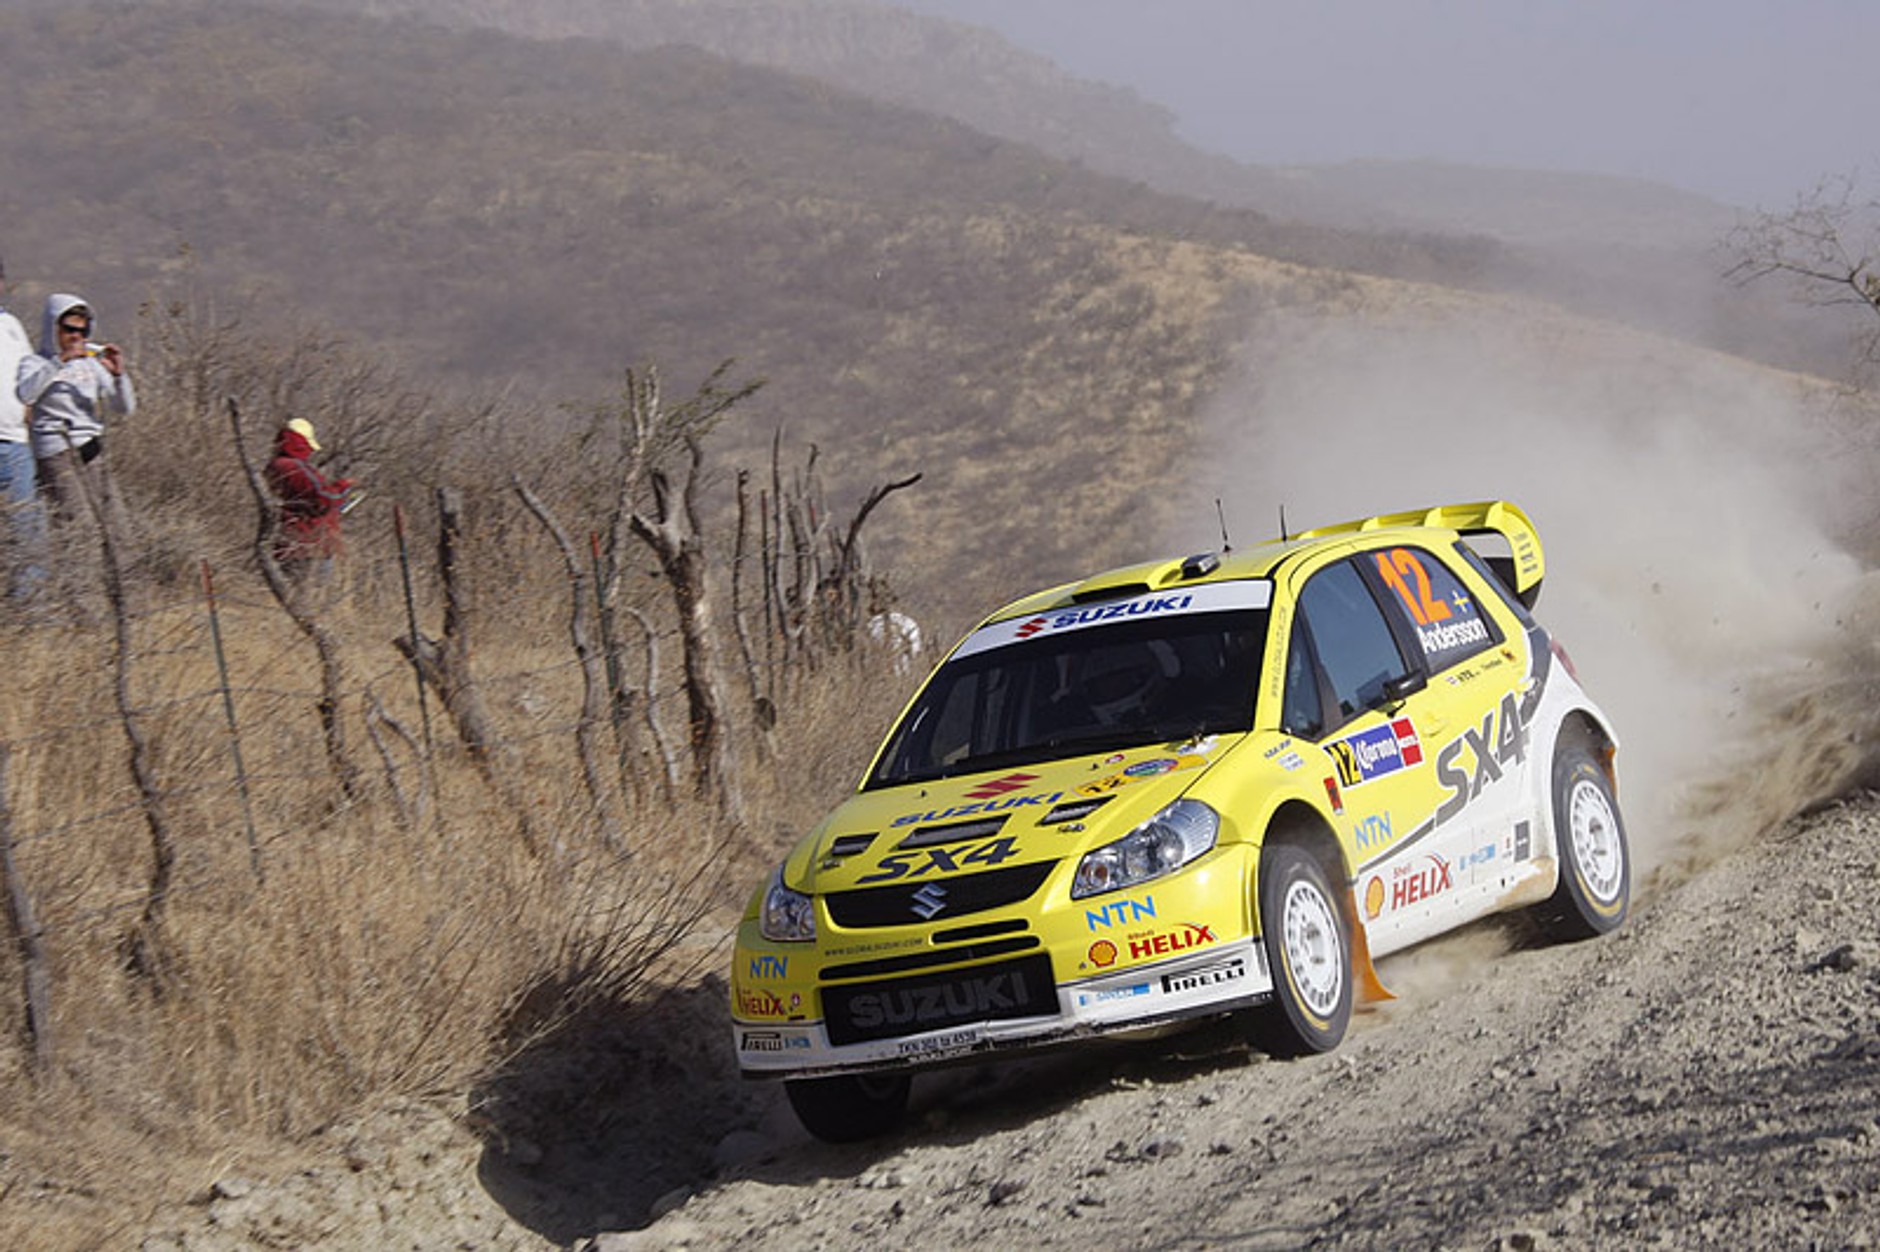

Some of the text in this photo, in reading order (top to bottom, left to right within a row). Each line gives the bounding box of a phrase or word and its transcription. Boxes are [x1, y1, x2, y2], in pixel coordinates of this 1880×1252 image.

[1376, 548, 1453, 626] 12
[1052, 595, 1193, 629] SUZUKI
[1416, 617, 1489, 655] Andersson
[1327, 741, 1362, 786] 12
[1355, 738, 1398, 771] Corona
[1436, 691, 1530, 828] SX4
[890, 791, 1065, 829] SUZUKI
[1354, 811, 1393, 849] NTN
[855, 836, 1023, 884] SX4
[1391, 856, 1451, 911] HELIX
[1085, 895, 1157, 931] NTN
[1129, 923, 1217, 959] HELIX
[750, 956, 788, 979] NTN
[1160, 958, 1246, 994] PIRELLI
[851, 971, 1030, 1028] SUZUKI
